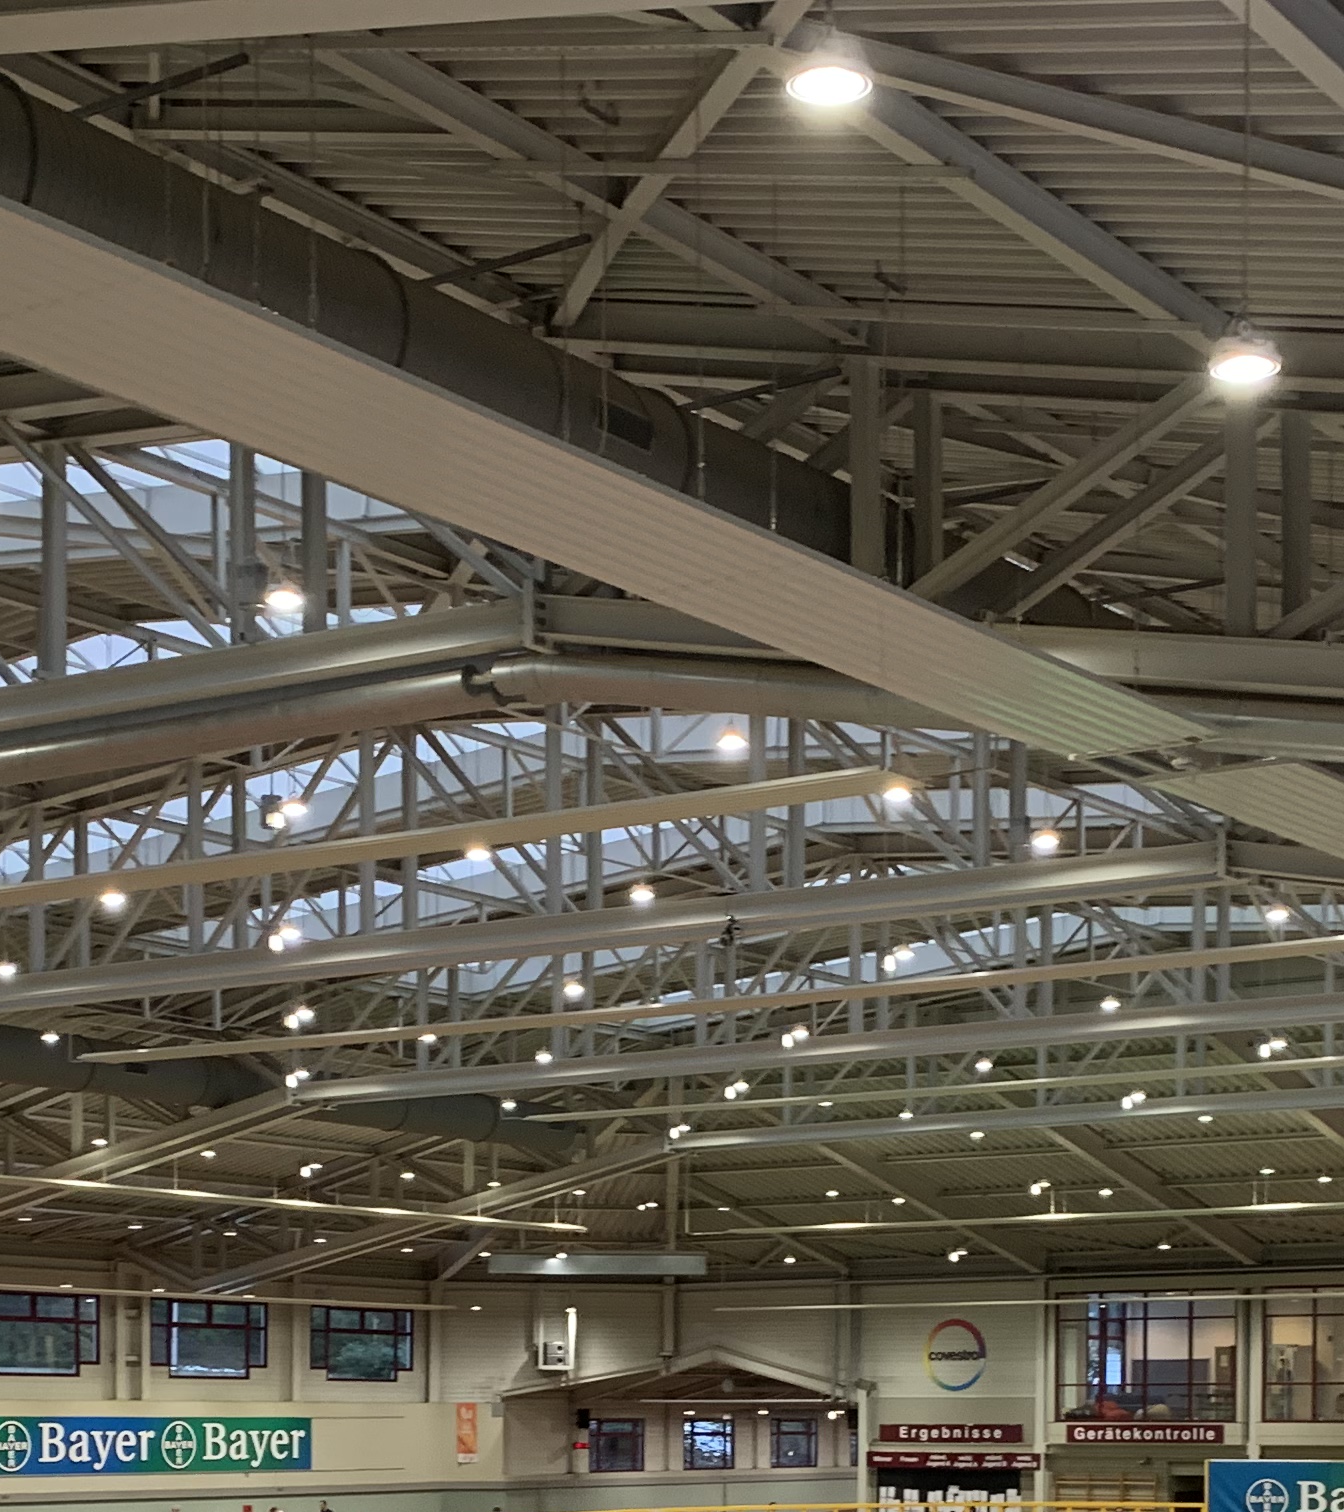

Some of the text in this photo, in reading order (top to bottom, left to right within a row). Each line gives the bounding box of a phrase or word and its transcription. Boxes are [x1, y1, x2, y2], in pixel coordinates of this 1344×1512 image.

[928, 1350, 979, 1361] covestro
[898, 1425, 1003, 1441] Ergebnisse
[1073, 1426, 1216, 1441] Gerätekontrolle
[37, 1421, 156, 1471] Bayer
[164, 1440, 194, 1450] BAYER
[201, 1422, 306, 1468] Bayer
[1249, 1494, 1286, 1504] BAYER
